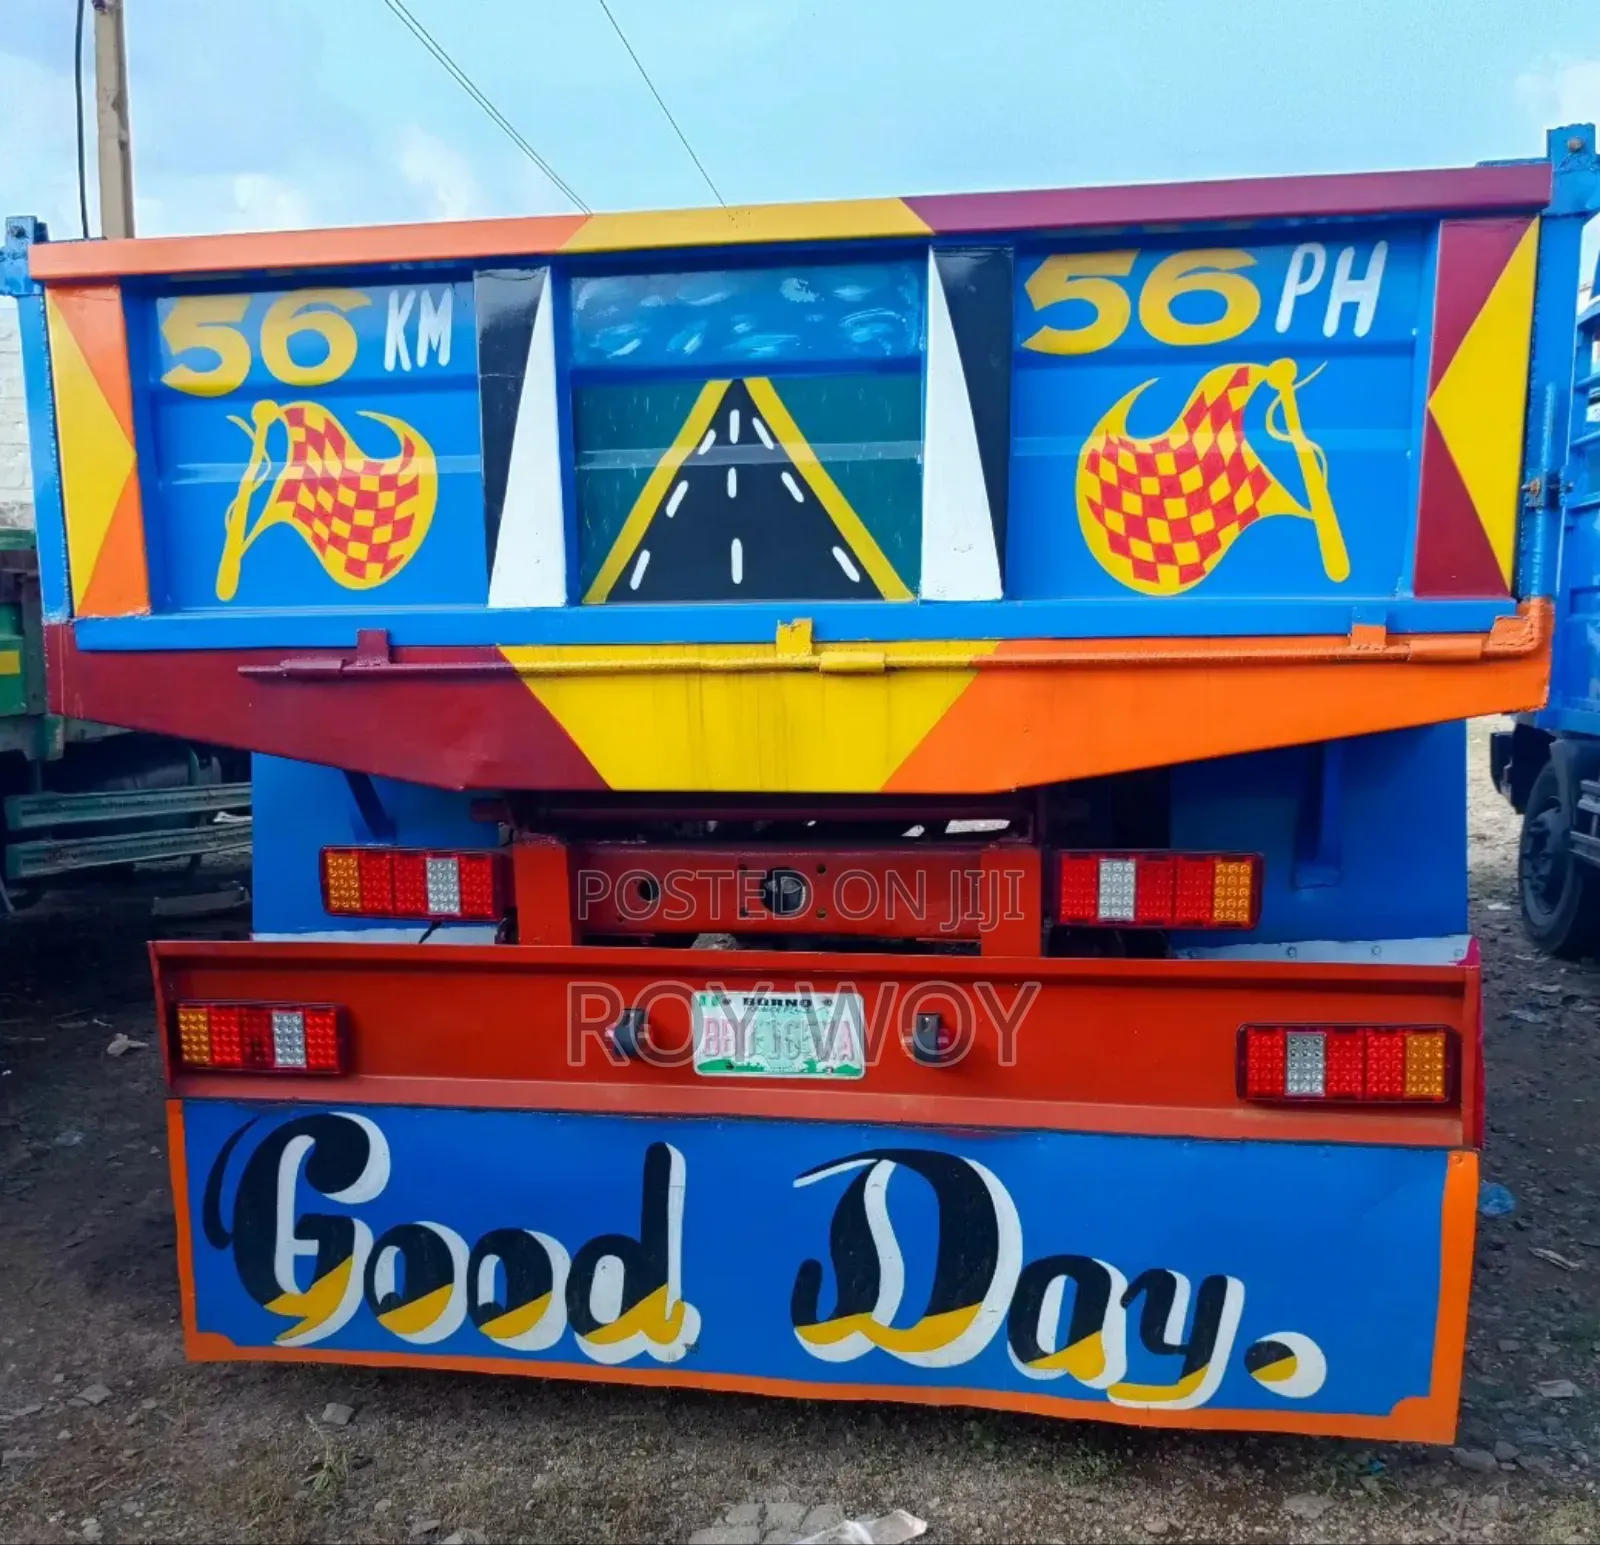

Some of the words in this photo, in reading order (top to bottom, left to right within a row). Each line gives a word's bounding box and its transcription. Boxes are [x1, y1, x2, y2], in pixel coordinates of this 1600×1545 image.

[159, 287, 372, 397] 56
[384, 287, 452, 371] KM
[1021, 247, 1262, 355] 56
[1275, 240, 1389, 337] PH
[202, 1111, 701, 1365] Good
[790, 1148, 1328, 1410] Day.
